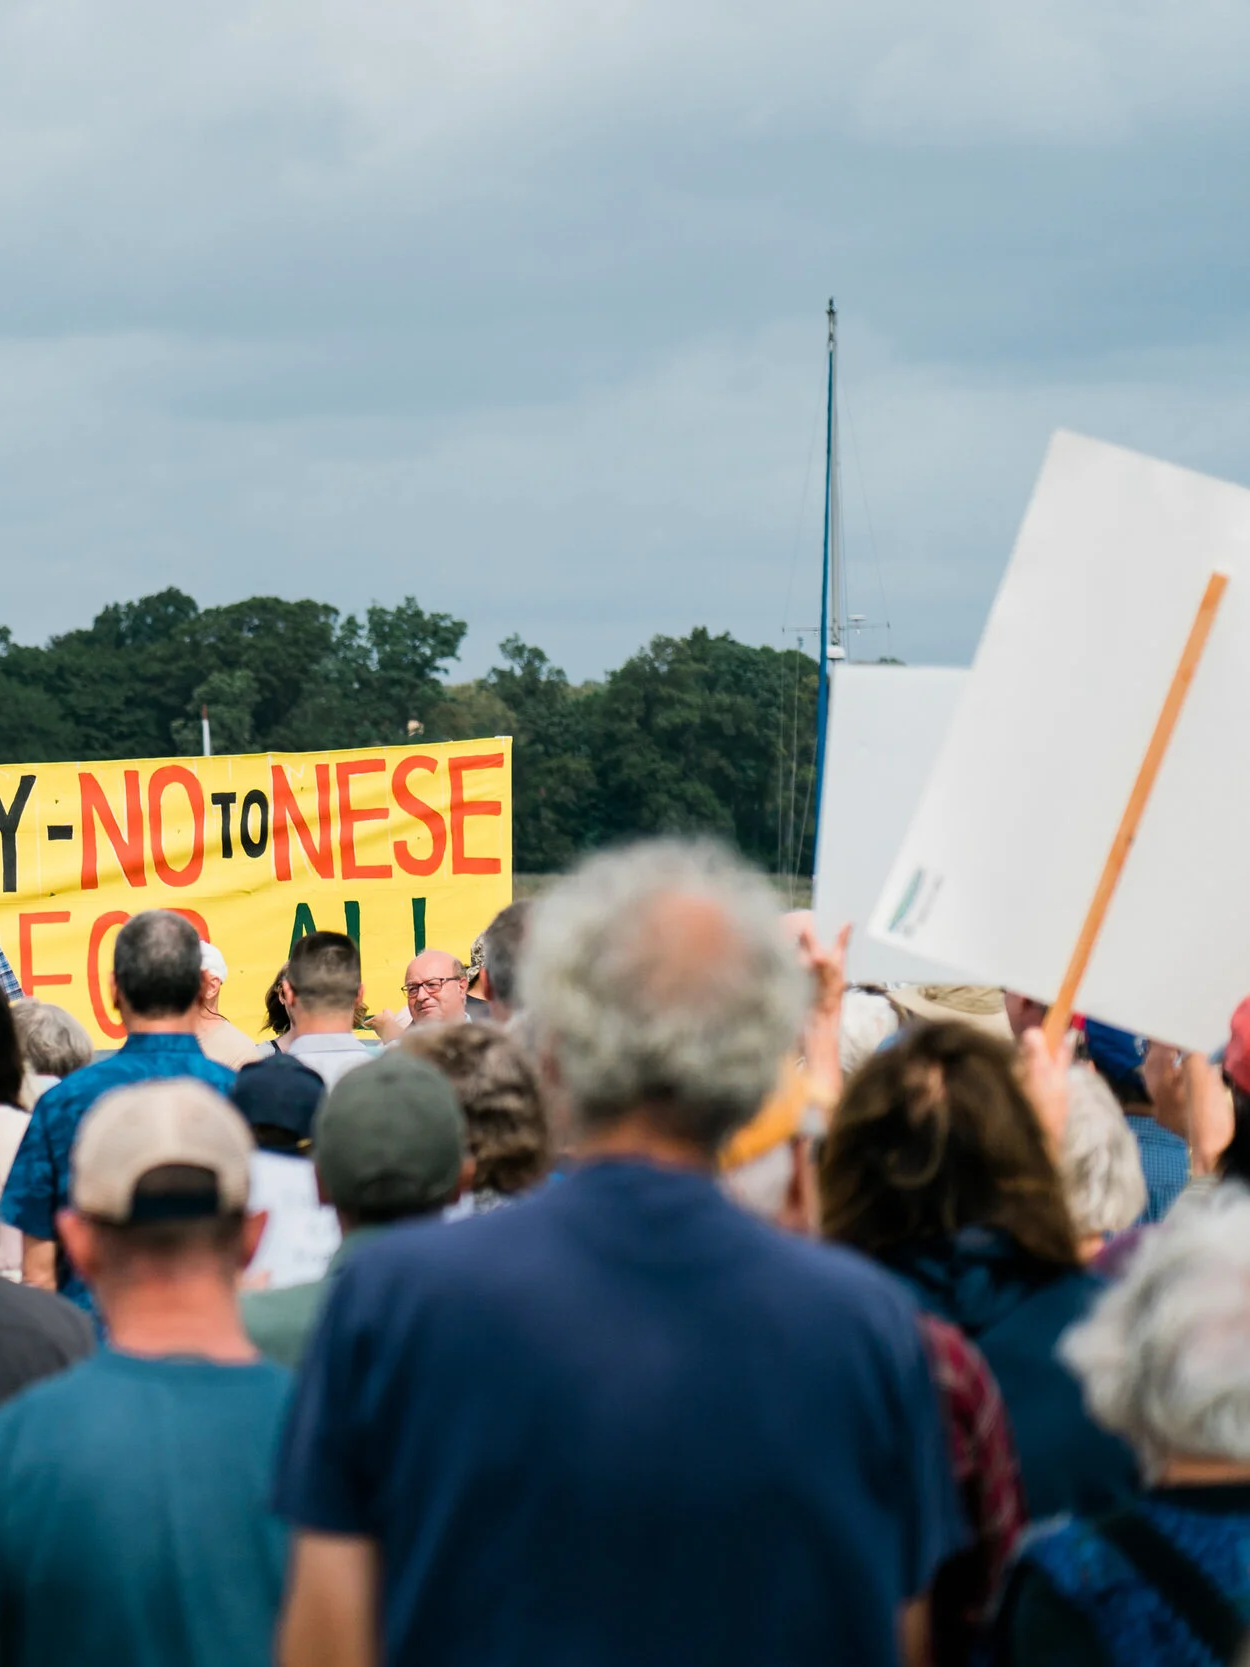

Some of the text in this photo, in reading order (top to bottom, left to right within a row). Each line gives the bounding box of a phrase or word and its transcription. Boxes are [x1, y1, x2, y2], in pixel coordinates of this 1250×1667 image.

[78, 764, 206, 890] NO
[211, 788, 269, 859] TO
[271, 752, 504, 882] NESE
[18, 908, 211, 1039] FO
